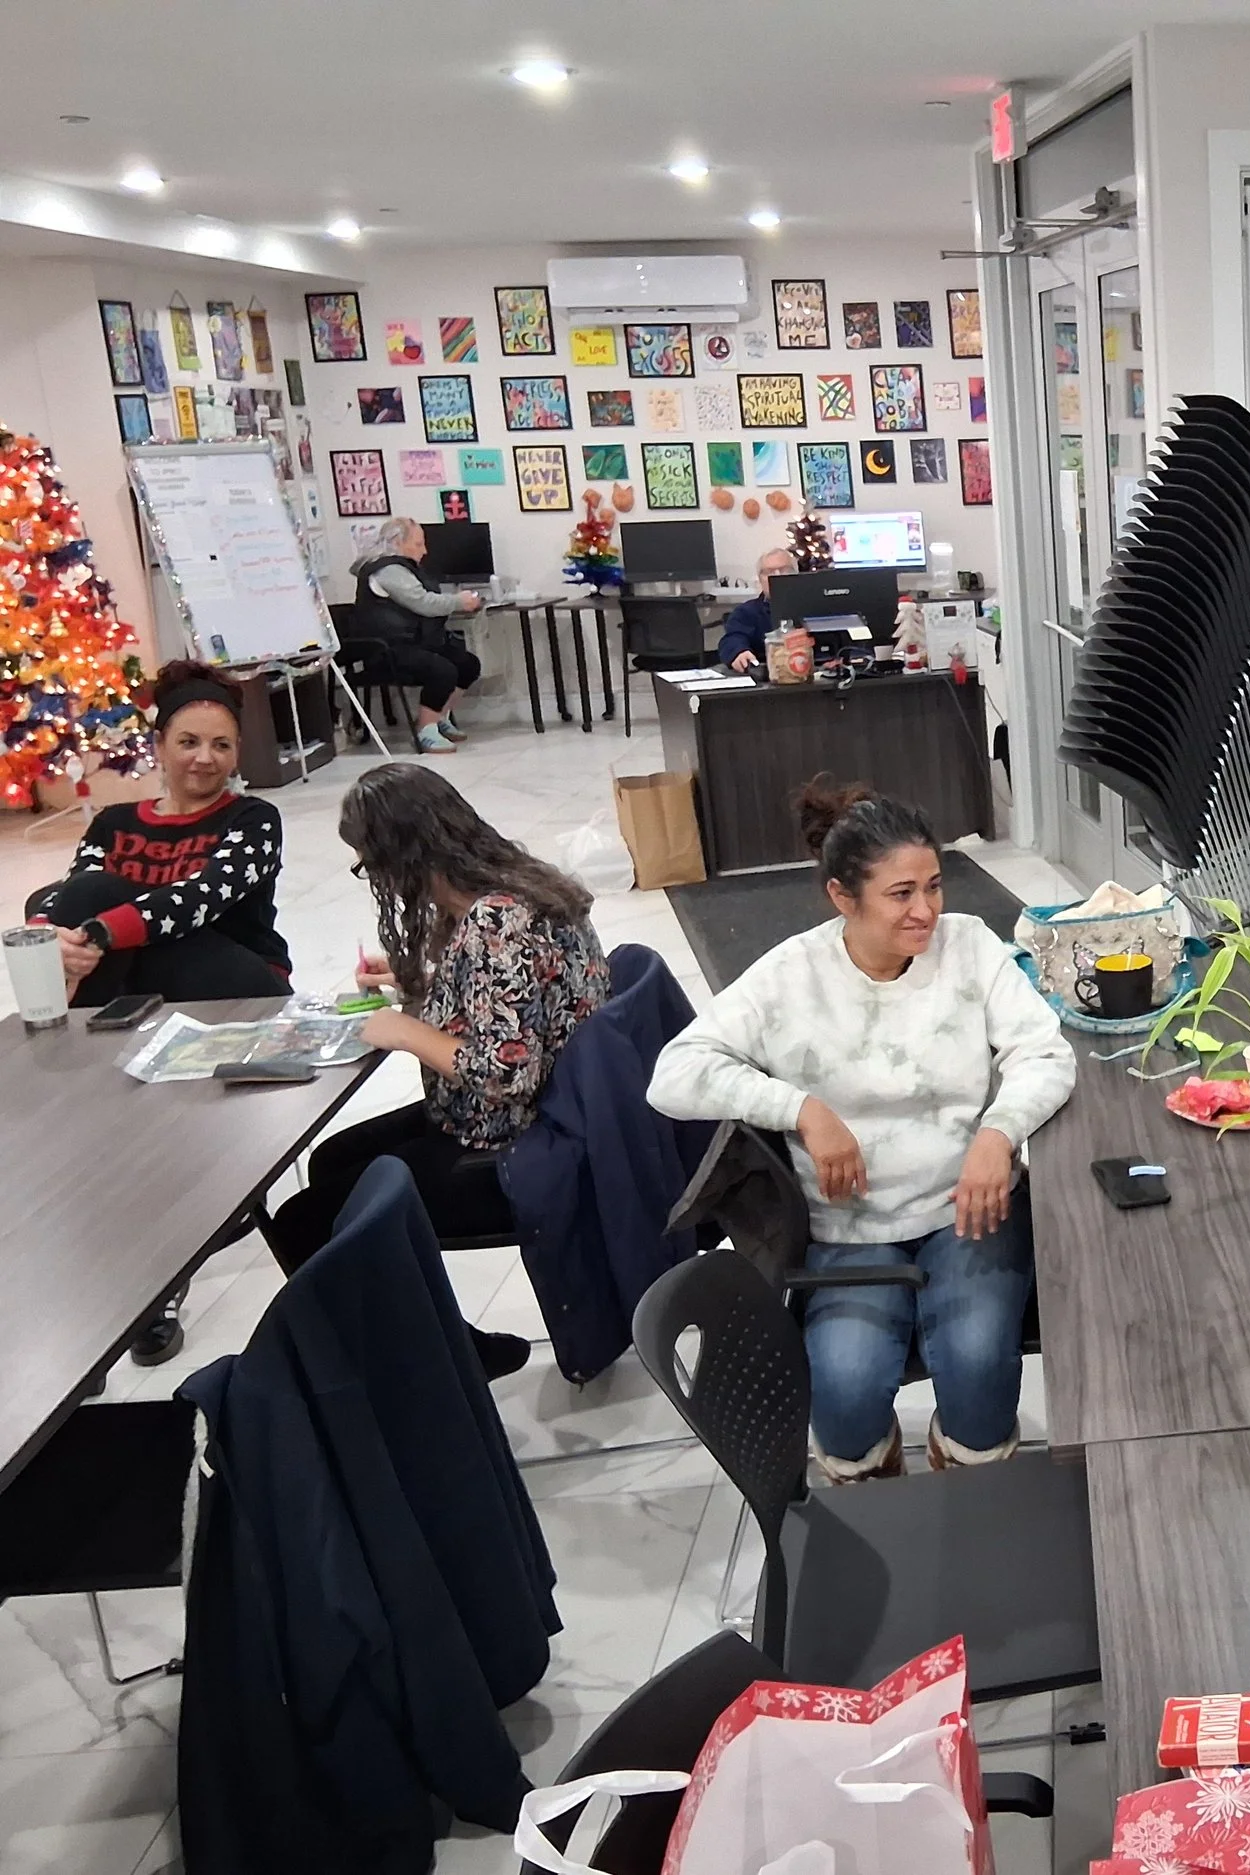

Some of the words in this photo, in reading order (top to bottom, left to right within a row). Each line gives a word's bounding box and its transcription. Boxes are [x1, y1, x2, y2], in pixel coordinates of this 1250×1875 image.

[504, 330, 549, 351] FACTS
[788, 334, 816, 347] ME
[747, 390, 803, 410] SPIRITUAL
[429, 417, 474, 431] NEVER
[744, 407, 804, 425] AWAKENING
[664, 447, 691, 460] ONLY
[802, 447, 817, 463] BE
[820, 447, 846, 460] KIND
[520, 468, 564, 485] GIVE
[660, 463, 692, 480] SICK
[806, 470, 848, 485] RESPECT
[526, 488, 559, 506] UP
[824, 588, 850, 596] Lenovo
[114, 830, 219, 860] Dear
[1199, 1698, 1240, 1742] AVIATOR
